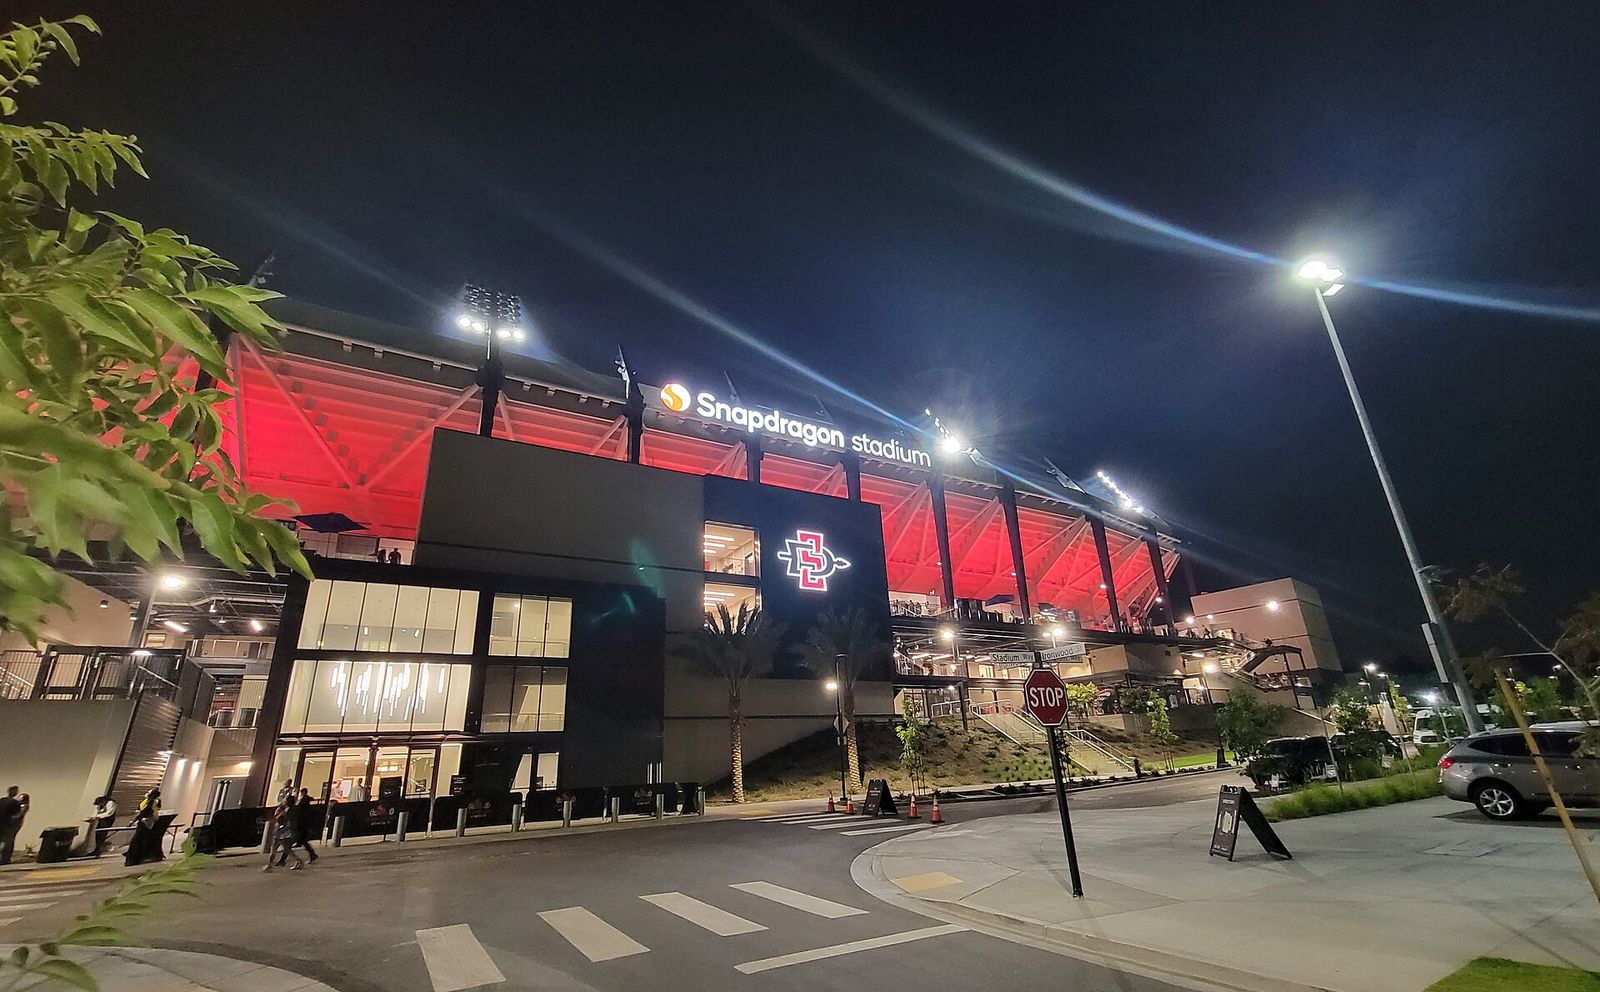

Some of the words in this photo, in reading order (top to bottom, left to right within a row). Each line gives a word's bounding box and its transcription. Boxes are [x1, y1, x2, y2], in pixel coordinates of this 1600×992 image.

[696, 392, 845, 448] Snapdragon
[851, 433, 932, 468] stadium
[992, 653, 1020, 662] Stadium
[1041, 647, 1074, 660] Ironwood
[1029, 686, 1064, 708] STOP
